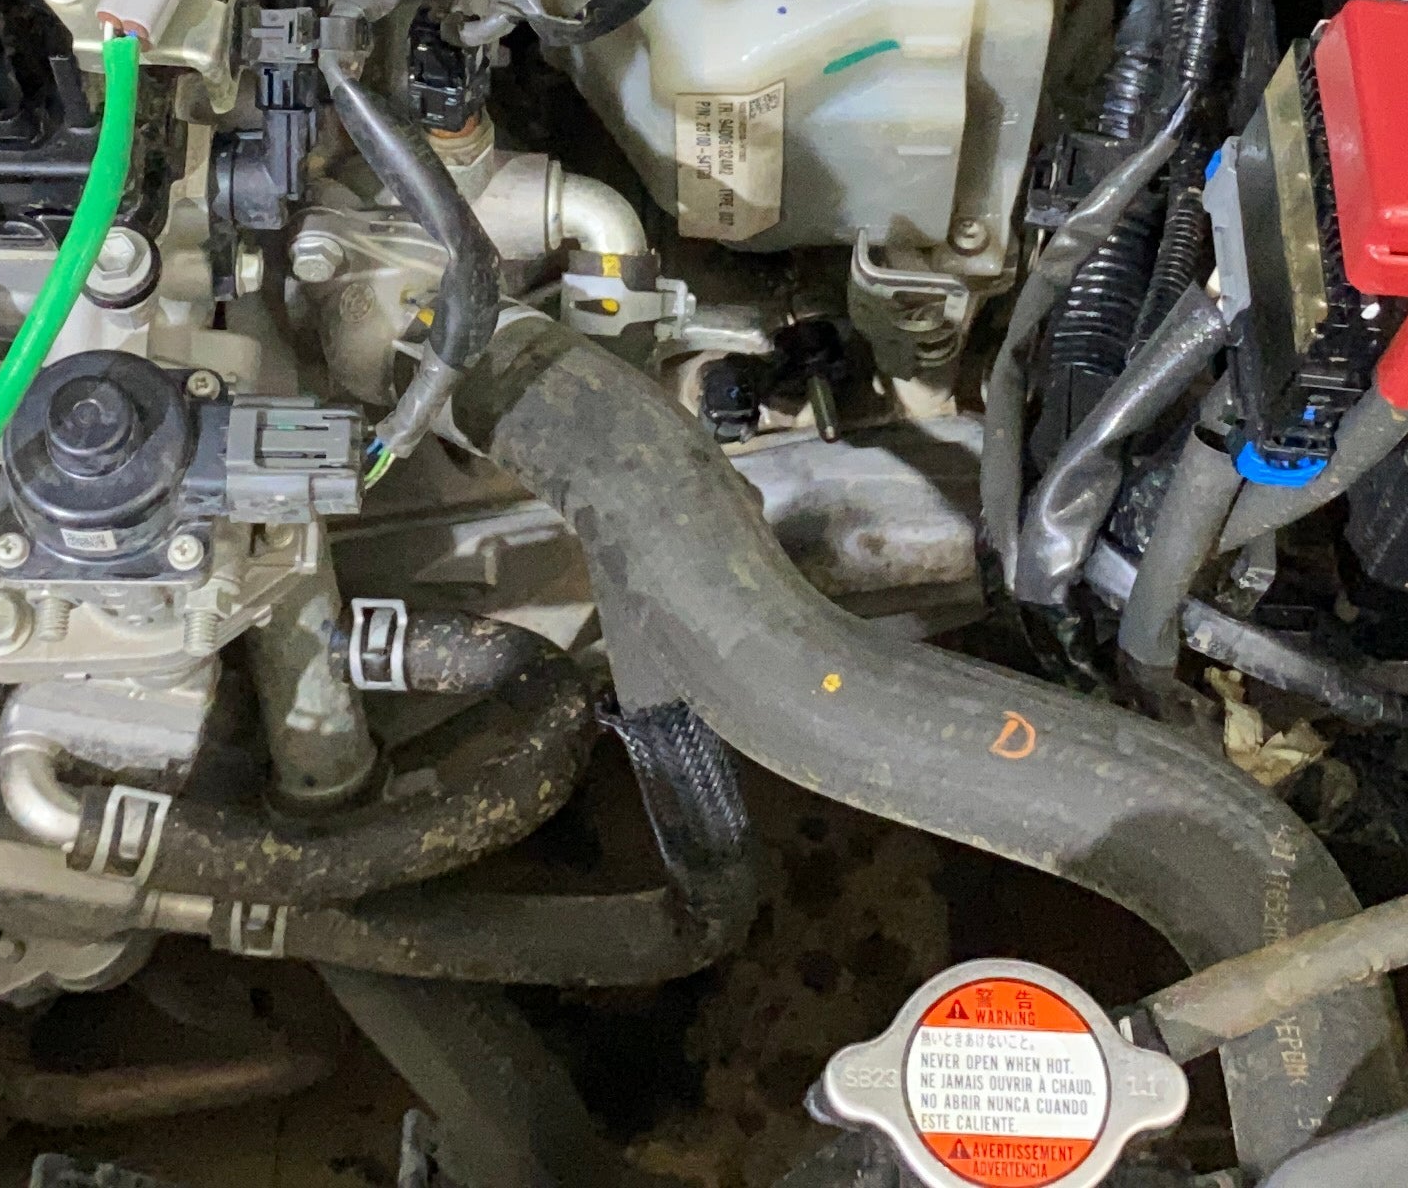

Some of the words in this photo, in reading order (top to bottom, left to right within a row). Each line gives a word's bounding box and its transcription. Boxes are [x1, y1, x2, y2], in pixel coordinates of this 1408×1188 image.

[989, 711, 1036, 759] D
[976, 989, 1033, 1009] 警告
[976, 1009, 1035, 1025] WARNING
[921, 1054, 959, 1069] NEVER
[967, 1055, 997, 1071] OPEN
[1004, 1056, 1040, 1072] WHEN
[1047, 1058, 1073, 1074] HOT.
[844, 1070, 897, 1088] SB23
[921, 1073, 936, 1087] NE
[941, 1074, 984, 1090] JAMAIS
[990, 1076, 1032, 1092] OUVRIR
[1039, 1075, 1046, 1093] À
[1052, 1078, 1096, 1095] CHAUD.
[921, 1093, 937, 1108] NO
[944, 1094, 980, 1110] ABRIR
[987, 1097, 1030, 1113] NUNCA
[1037, 1099, 1088, 1115] CUANDO
[921, 1115, 949, 1129] ESTE
[957, 1117, 1019, 1132] CALIENTE.
[973, 1143, 1073, 1161] AVERTISSEMENT
[973, 1161, 1047, 1178] ADVERTENCIA
